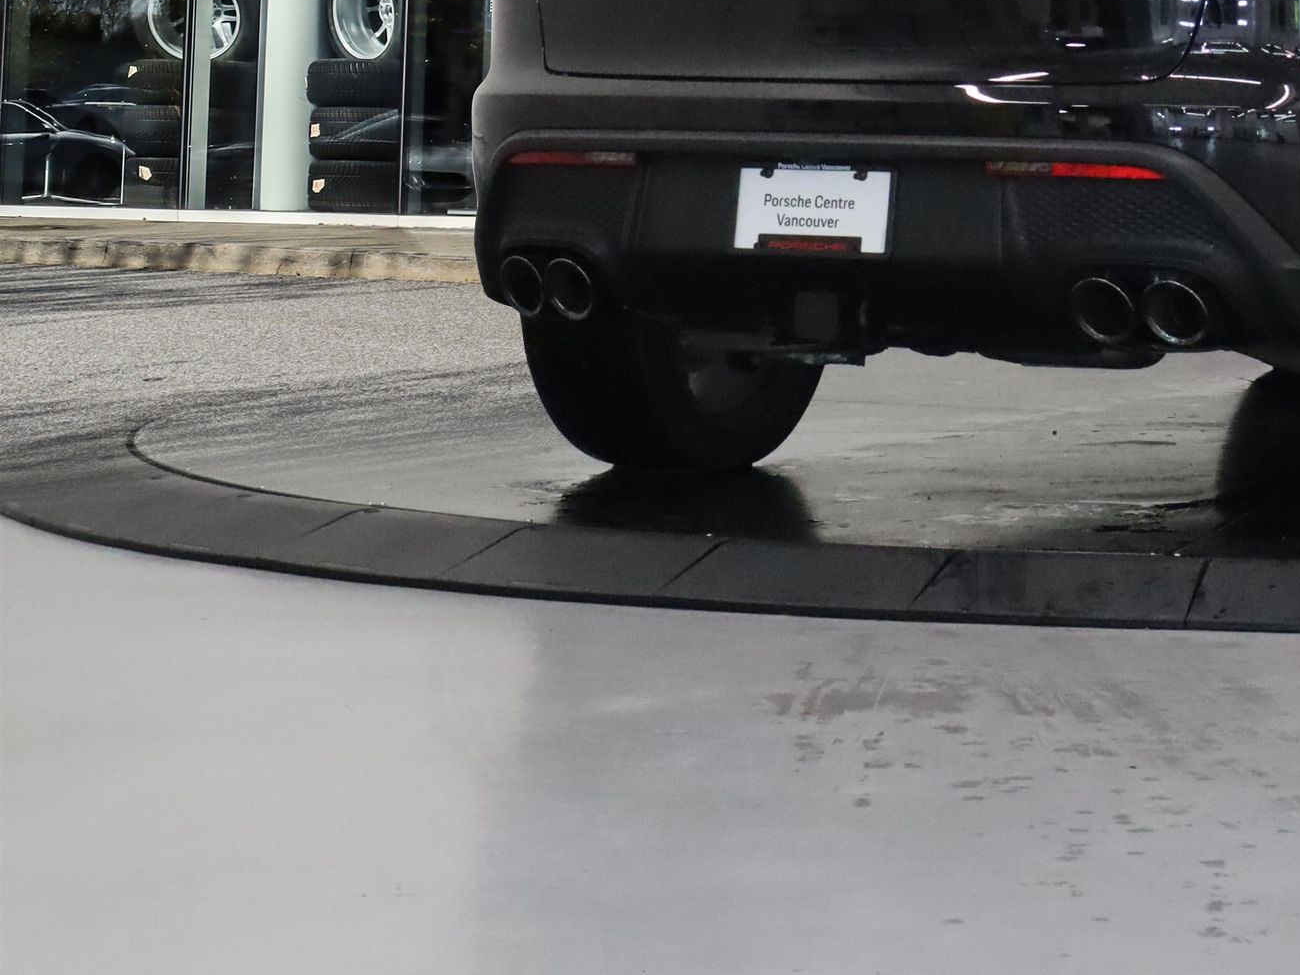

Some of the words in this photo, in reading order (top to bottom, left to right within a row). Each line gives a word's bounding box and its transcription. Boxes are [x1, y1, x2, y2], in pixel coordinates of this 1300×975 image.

[763, 193, 812, 209] Porsche
[814, 195, 856, 210] Centre
[776, 213, 840, 229] Vancouver
